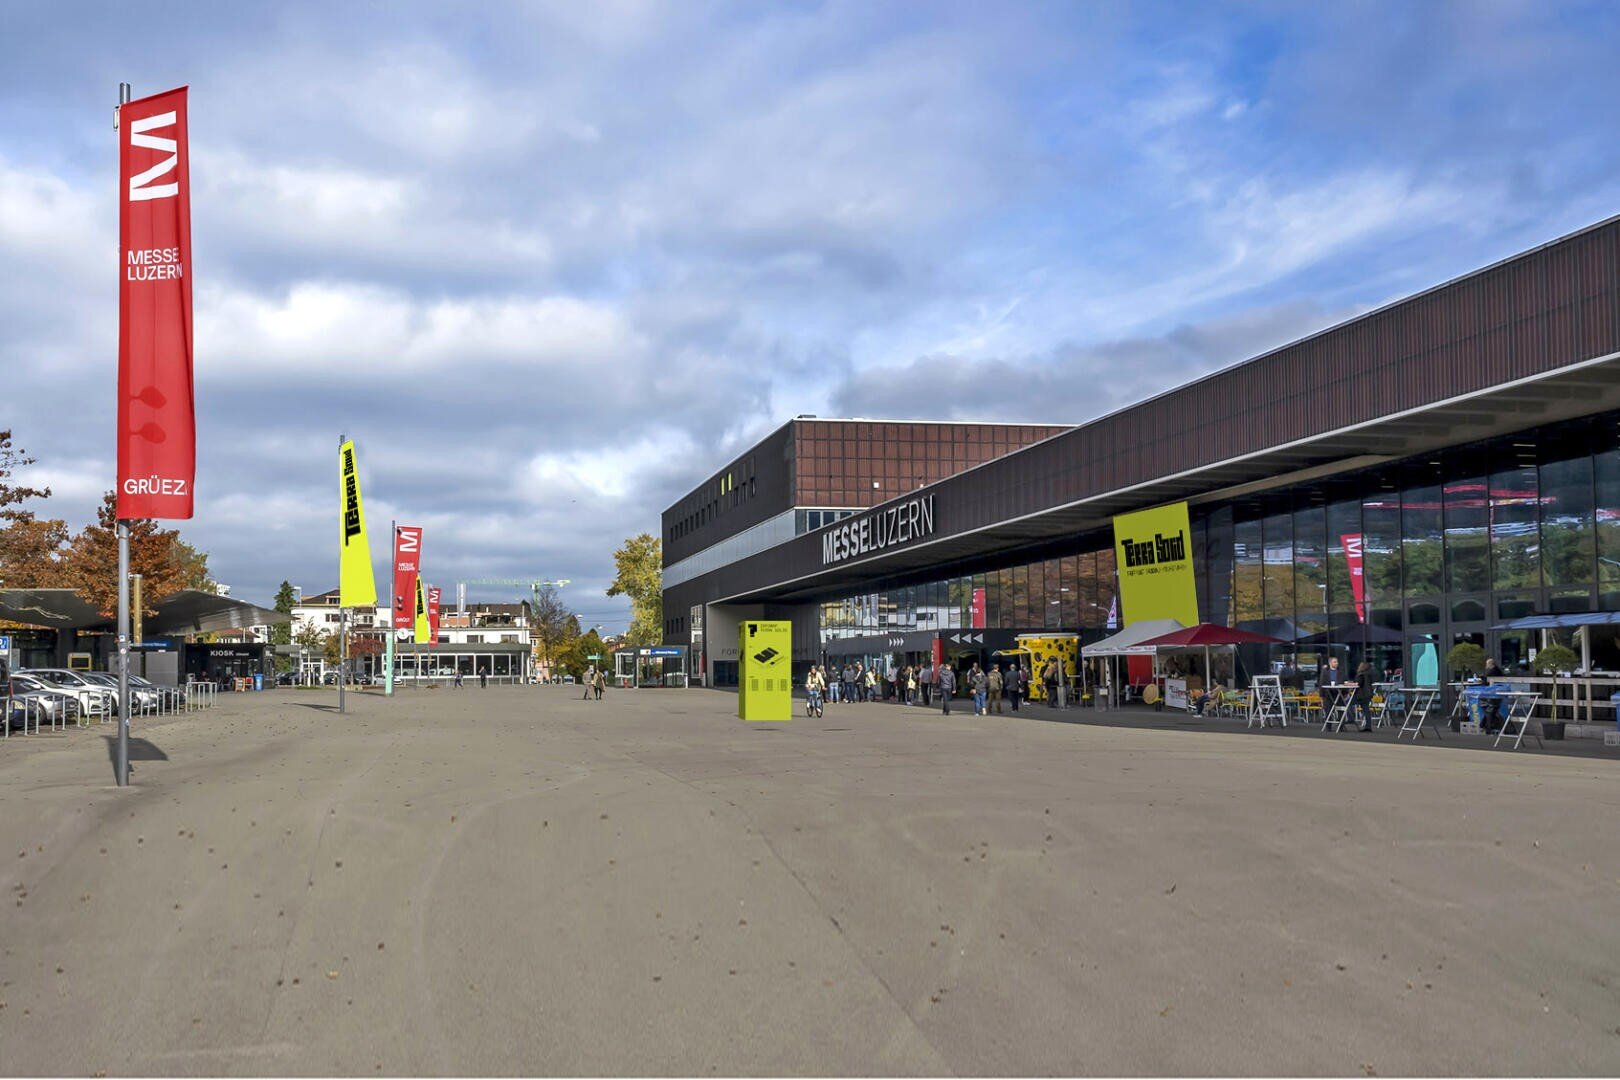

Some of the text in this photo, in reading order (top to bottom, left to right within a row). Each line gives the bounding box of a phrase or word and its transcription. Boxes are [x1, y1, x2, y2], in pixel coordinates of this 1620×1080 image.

[127, 247, 180, 265] MESSE
[127, 262, 183, 281] LUZERN
[123, 474, 188, 496] GRÜEZ
